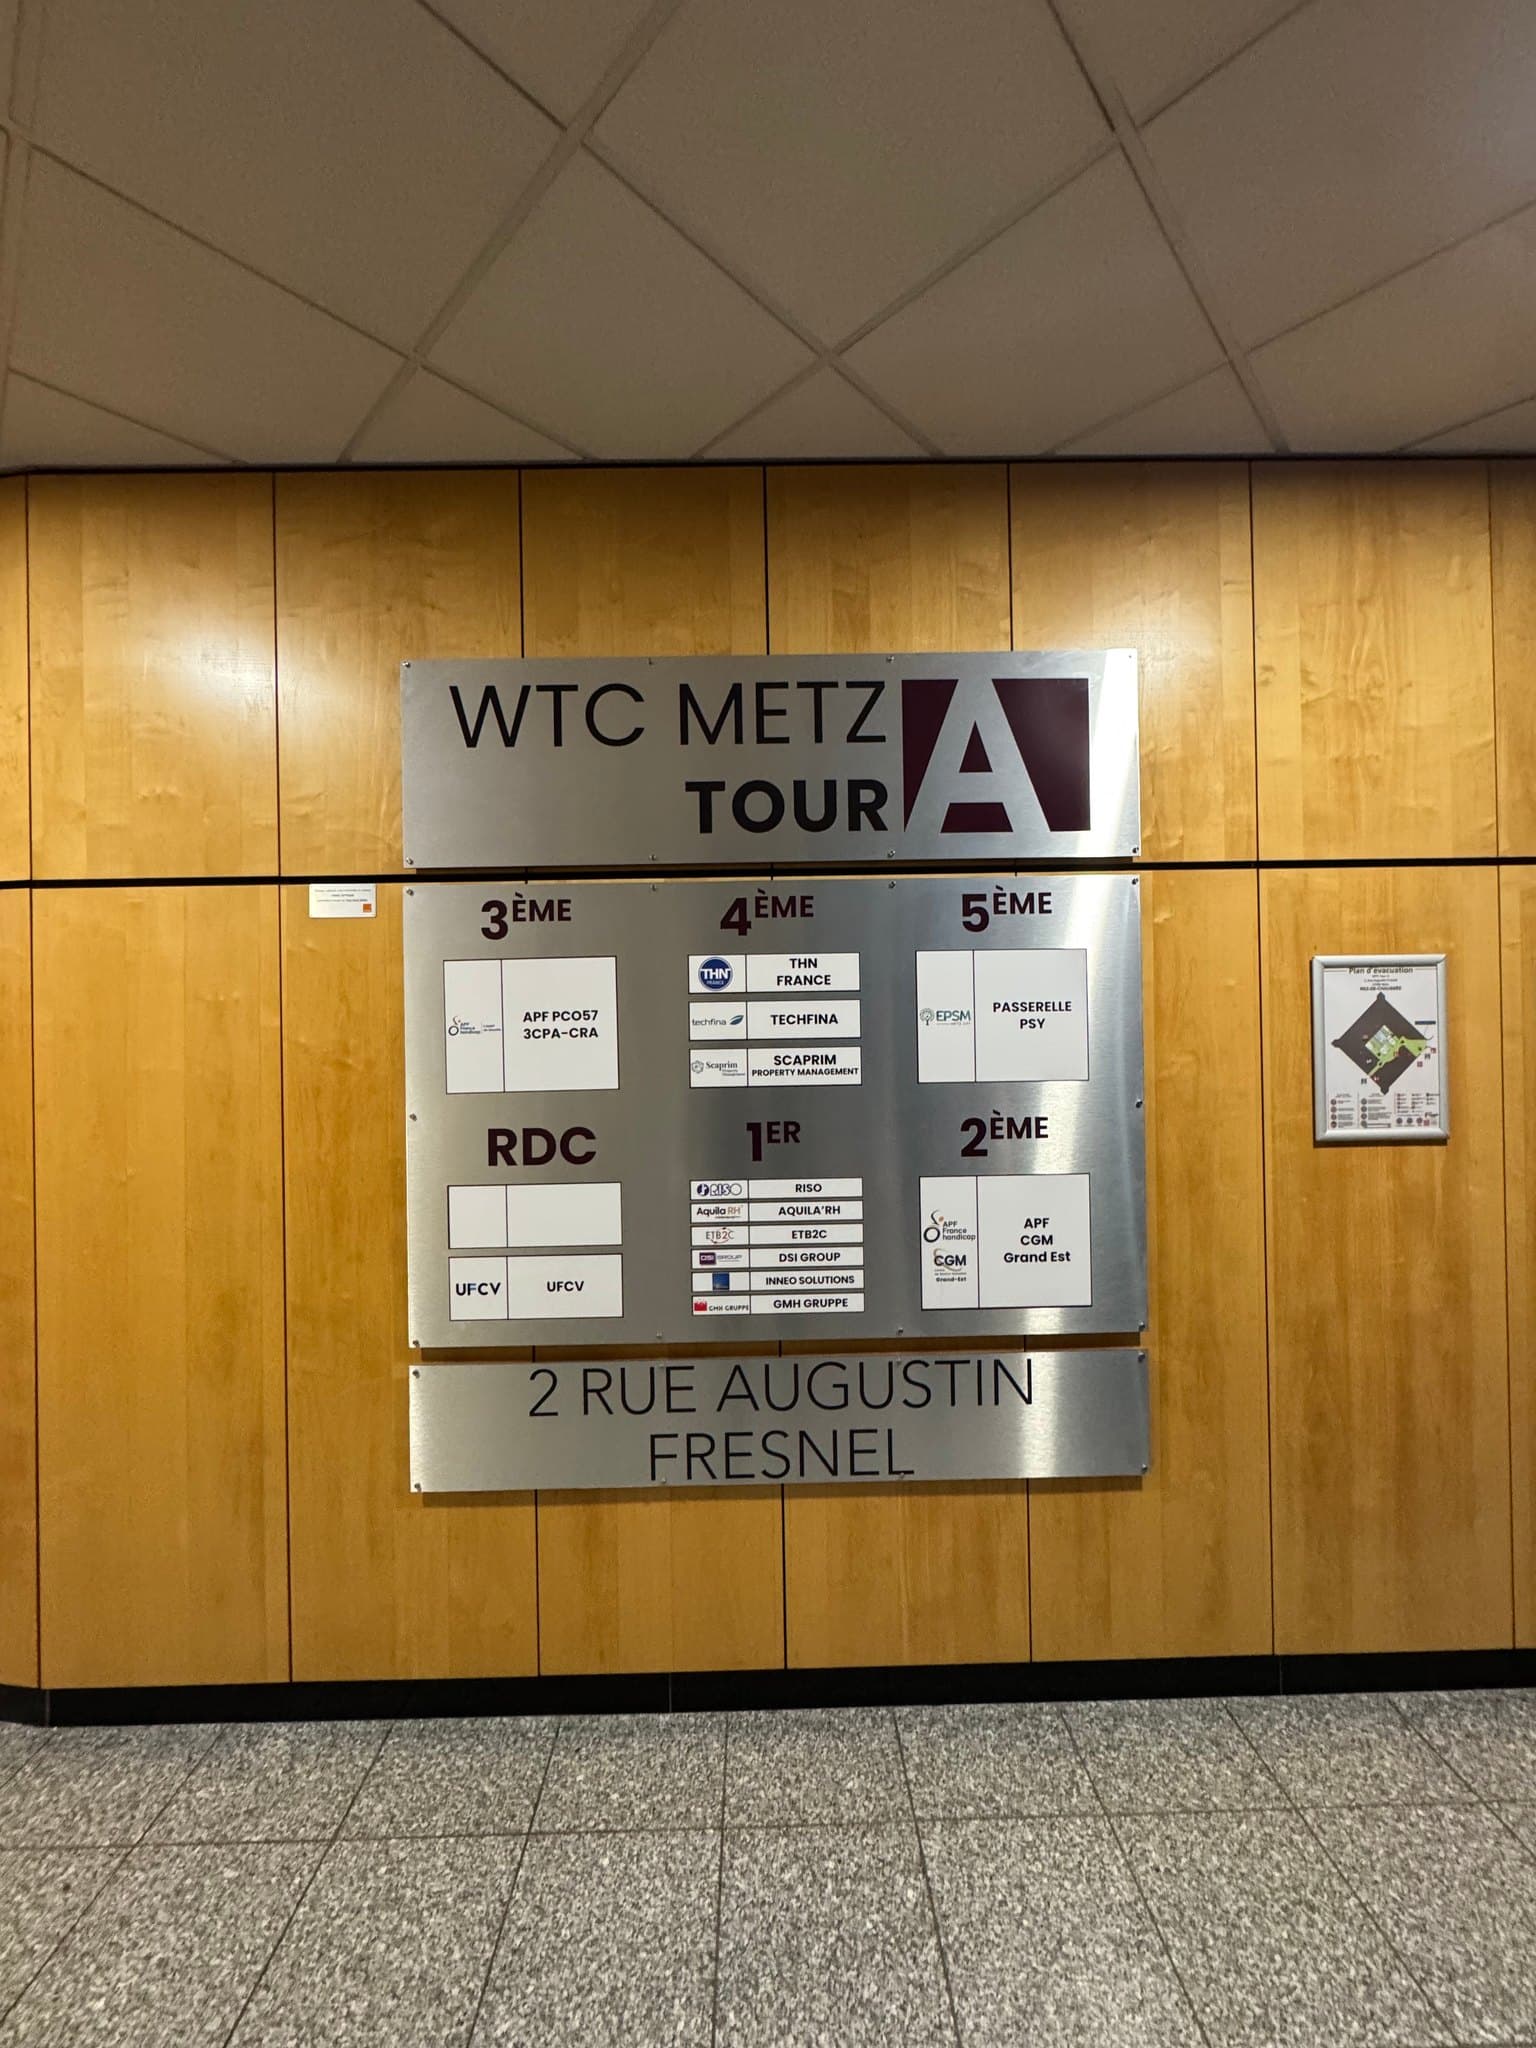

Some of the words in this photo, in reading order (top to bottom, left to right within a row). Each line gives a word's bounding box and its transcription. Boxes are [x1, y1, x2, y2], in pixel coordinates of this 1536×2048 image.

[449, 683, 645, 748] WTC
[679, 681, 886, 745] METZ
[904, 678, 1051, 833] A
[685, 779, 888, 834] TOUR
[720, 888, 814, 936] 4ÈME
[962, 884, 1052, 932] 5ÈME
[481, 892, 571, 940] 3ÈME
[789, 957, 818, 969] THN
[776, 974, 832, 986] FRANCE
[993, 1001, 1073, 1013] PASSERELLE
[522, 1010, 550, 1023] APF
[691, 1017, 727, 1026] techfina
[770, 1013, 839, 1025] TECHFINA
[936, 1009, 971, 1022] EPSM
[1019, 1018, 1046, 1030] PSY
[523, 1027, 599, 1040] 3CPA-CRA
[705, 1060, 738, 1072] Scaprim
[773, 1054, 837, 1066] SCAPRIM
[751, 1067, 795, 1077] PROPERTY
[797, 1067, 859, 1076] MANAGEMENT
[961, 1110, 1048, 1157] 2ÈME
[488, 1126, 597, 1167] RDC
[746, 1121, 801, 1162] 1ER
[709, 1183, 743, 1196] RISO
[795, 1183, 823, 1193] RISO
[696, 1206, 726, 1217] Aquila
[728, 1206, 741, 1215] RH
[1023, 1218, 1050, 1229] APF
[705, 1230, 735, 1240] ETB2C
[791, 1229, 828, 1240] ETB2C
[943, 1234, 976, 1242] handicap
[1020, 1235, 1054, 1246] CGM
[779, 1252, 798, 1263] DSI
[801, 1252, 841, 1263] GROUP
[934, 1254, 967, 1266] CGM
[1003, 1252, 1049, 1263] Grand
[1051, 1251, 1071, 1262] Est
[546, 1281, 585, 1292] UFCV
[765, 1275, 798, 1286] INNEO
[799, 1275, 855, 1285] SOLUTIONS
[456, 1282, 501, 1296] UFCV
[773, 1299, 801, 1310] GMH
[803, 1297, 849, 1309] GRUPPE
[529, 1368, 560, 1418] 2
[582, 1365, 697, 1416] RUE
[716, 1358, 1034, 1412] AUGUSTIN
[649, 1429, 915, 1481] FRESNEL
